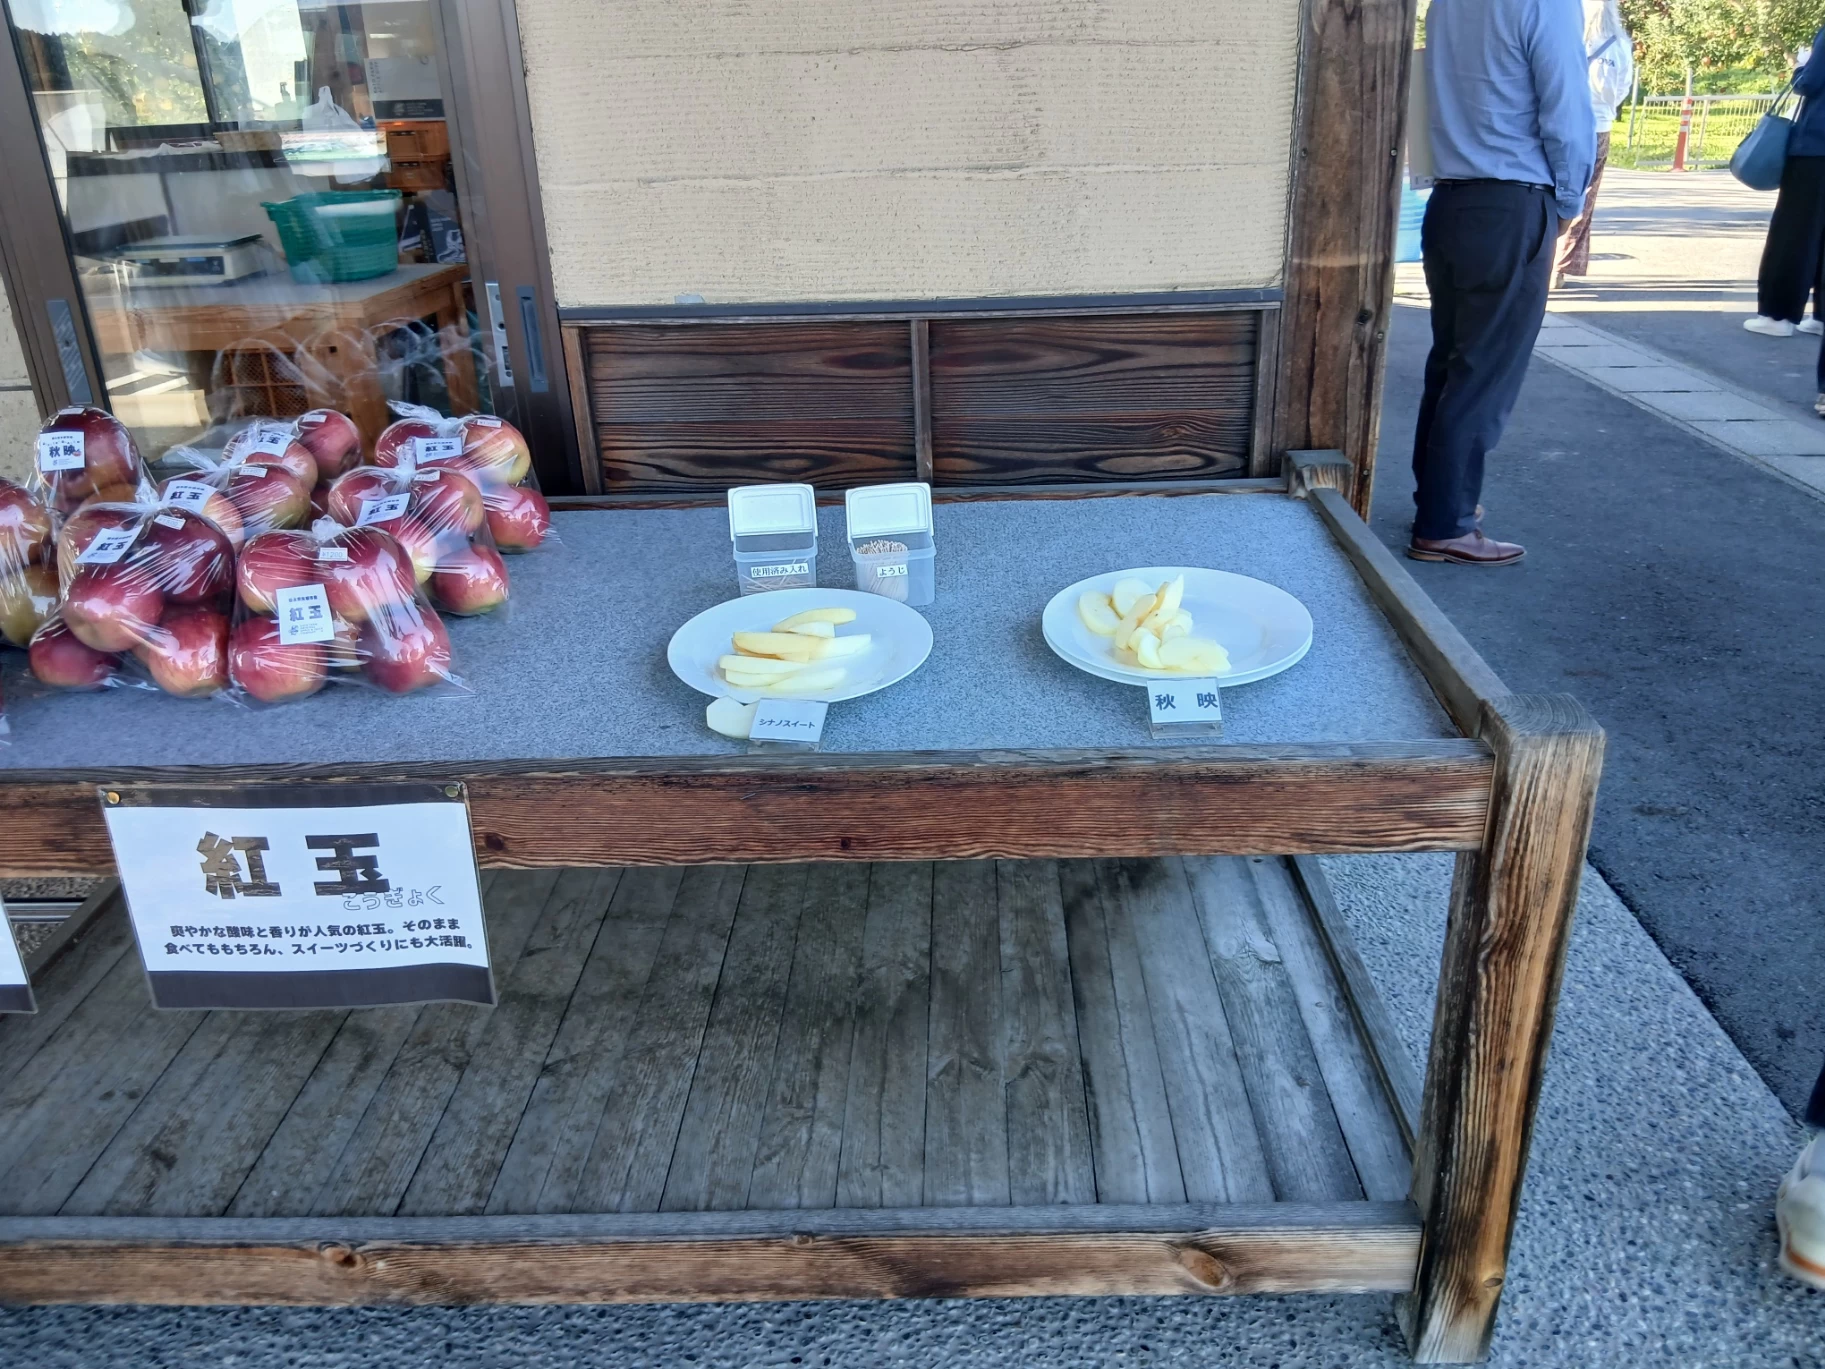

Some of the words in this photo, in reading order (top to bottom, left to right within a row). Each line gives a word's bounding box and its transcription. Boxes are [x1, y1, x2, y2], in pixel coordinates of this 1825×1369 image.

[49, 444, 75, 458] 秋映
[752, 563, 807, 576] 使用済み入れ
[879, 567, 906, 576] ようじ
[289, 604, 323, 622] 紅玉
[759, 718, 816, 729] シナノスイート
[196, 831, 391, 900] 紅玉
[341, 885, 445, 911] こうぎょく
[170, 917, 461, 939] 爽やかな酸味と香りが人気の紅玉。そのまま
[164, 934, 473, 956] 食べてももちろん、スイーツづくりにも大活躍。
